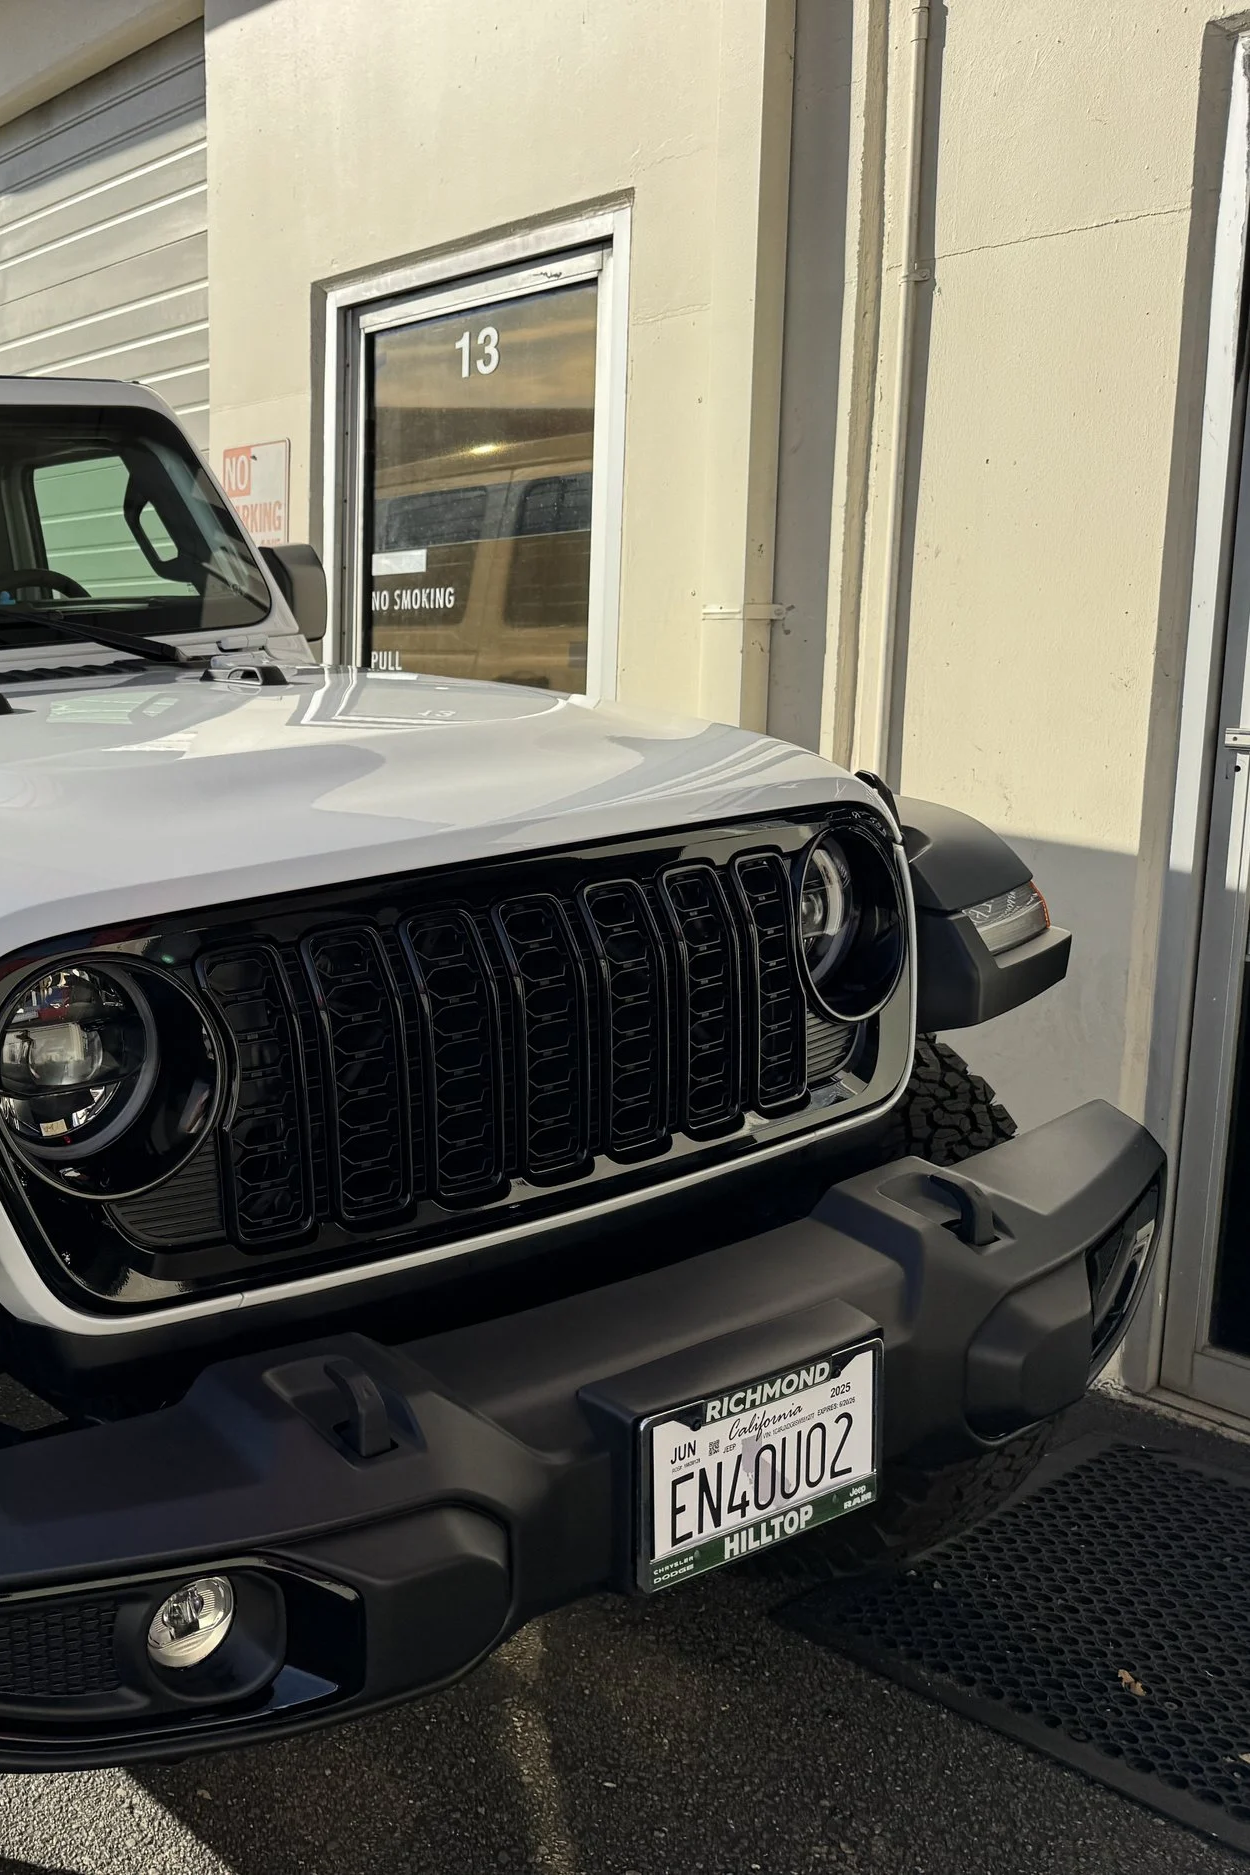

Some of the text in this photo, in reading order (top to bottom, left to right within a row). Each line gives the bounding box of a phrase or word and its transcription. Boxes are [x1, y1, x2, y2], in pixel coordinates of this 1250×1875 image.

[455, 326, 499, 378] 13
[224, 454, 250, 493] NO
[235, 500, 282, 533] RKING
[371, 586, 455, 612] NO SMOKING
[371, 650, 402, 672] PULL
[705, 1361, 830, 1423] RICHMOND
[830, 1382, 851, 1398] 2025
[728, 1403, 803, 1441] California
[670, 1440, 697, 1465] JUN
[723, 1443, 737, 1454] JEEP
[671, 1411, 854, 1548] EN40U02
[849, 1485, 866, 1497] Jeep
[843, 1491, 872, 1510] RAM
[724, 1504, 814, 1560] HILLTOP
[653, 1555, 694, 1576] CHRYSLER
[653, 1563, 694, 1584] DODGE
